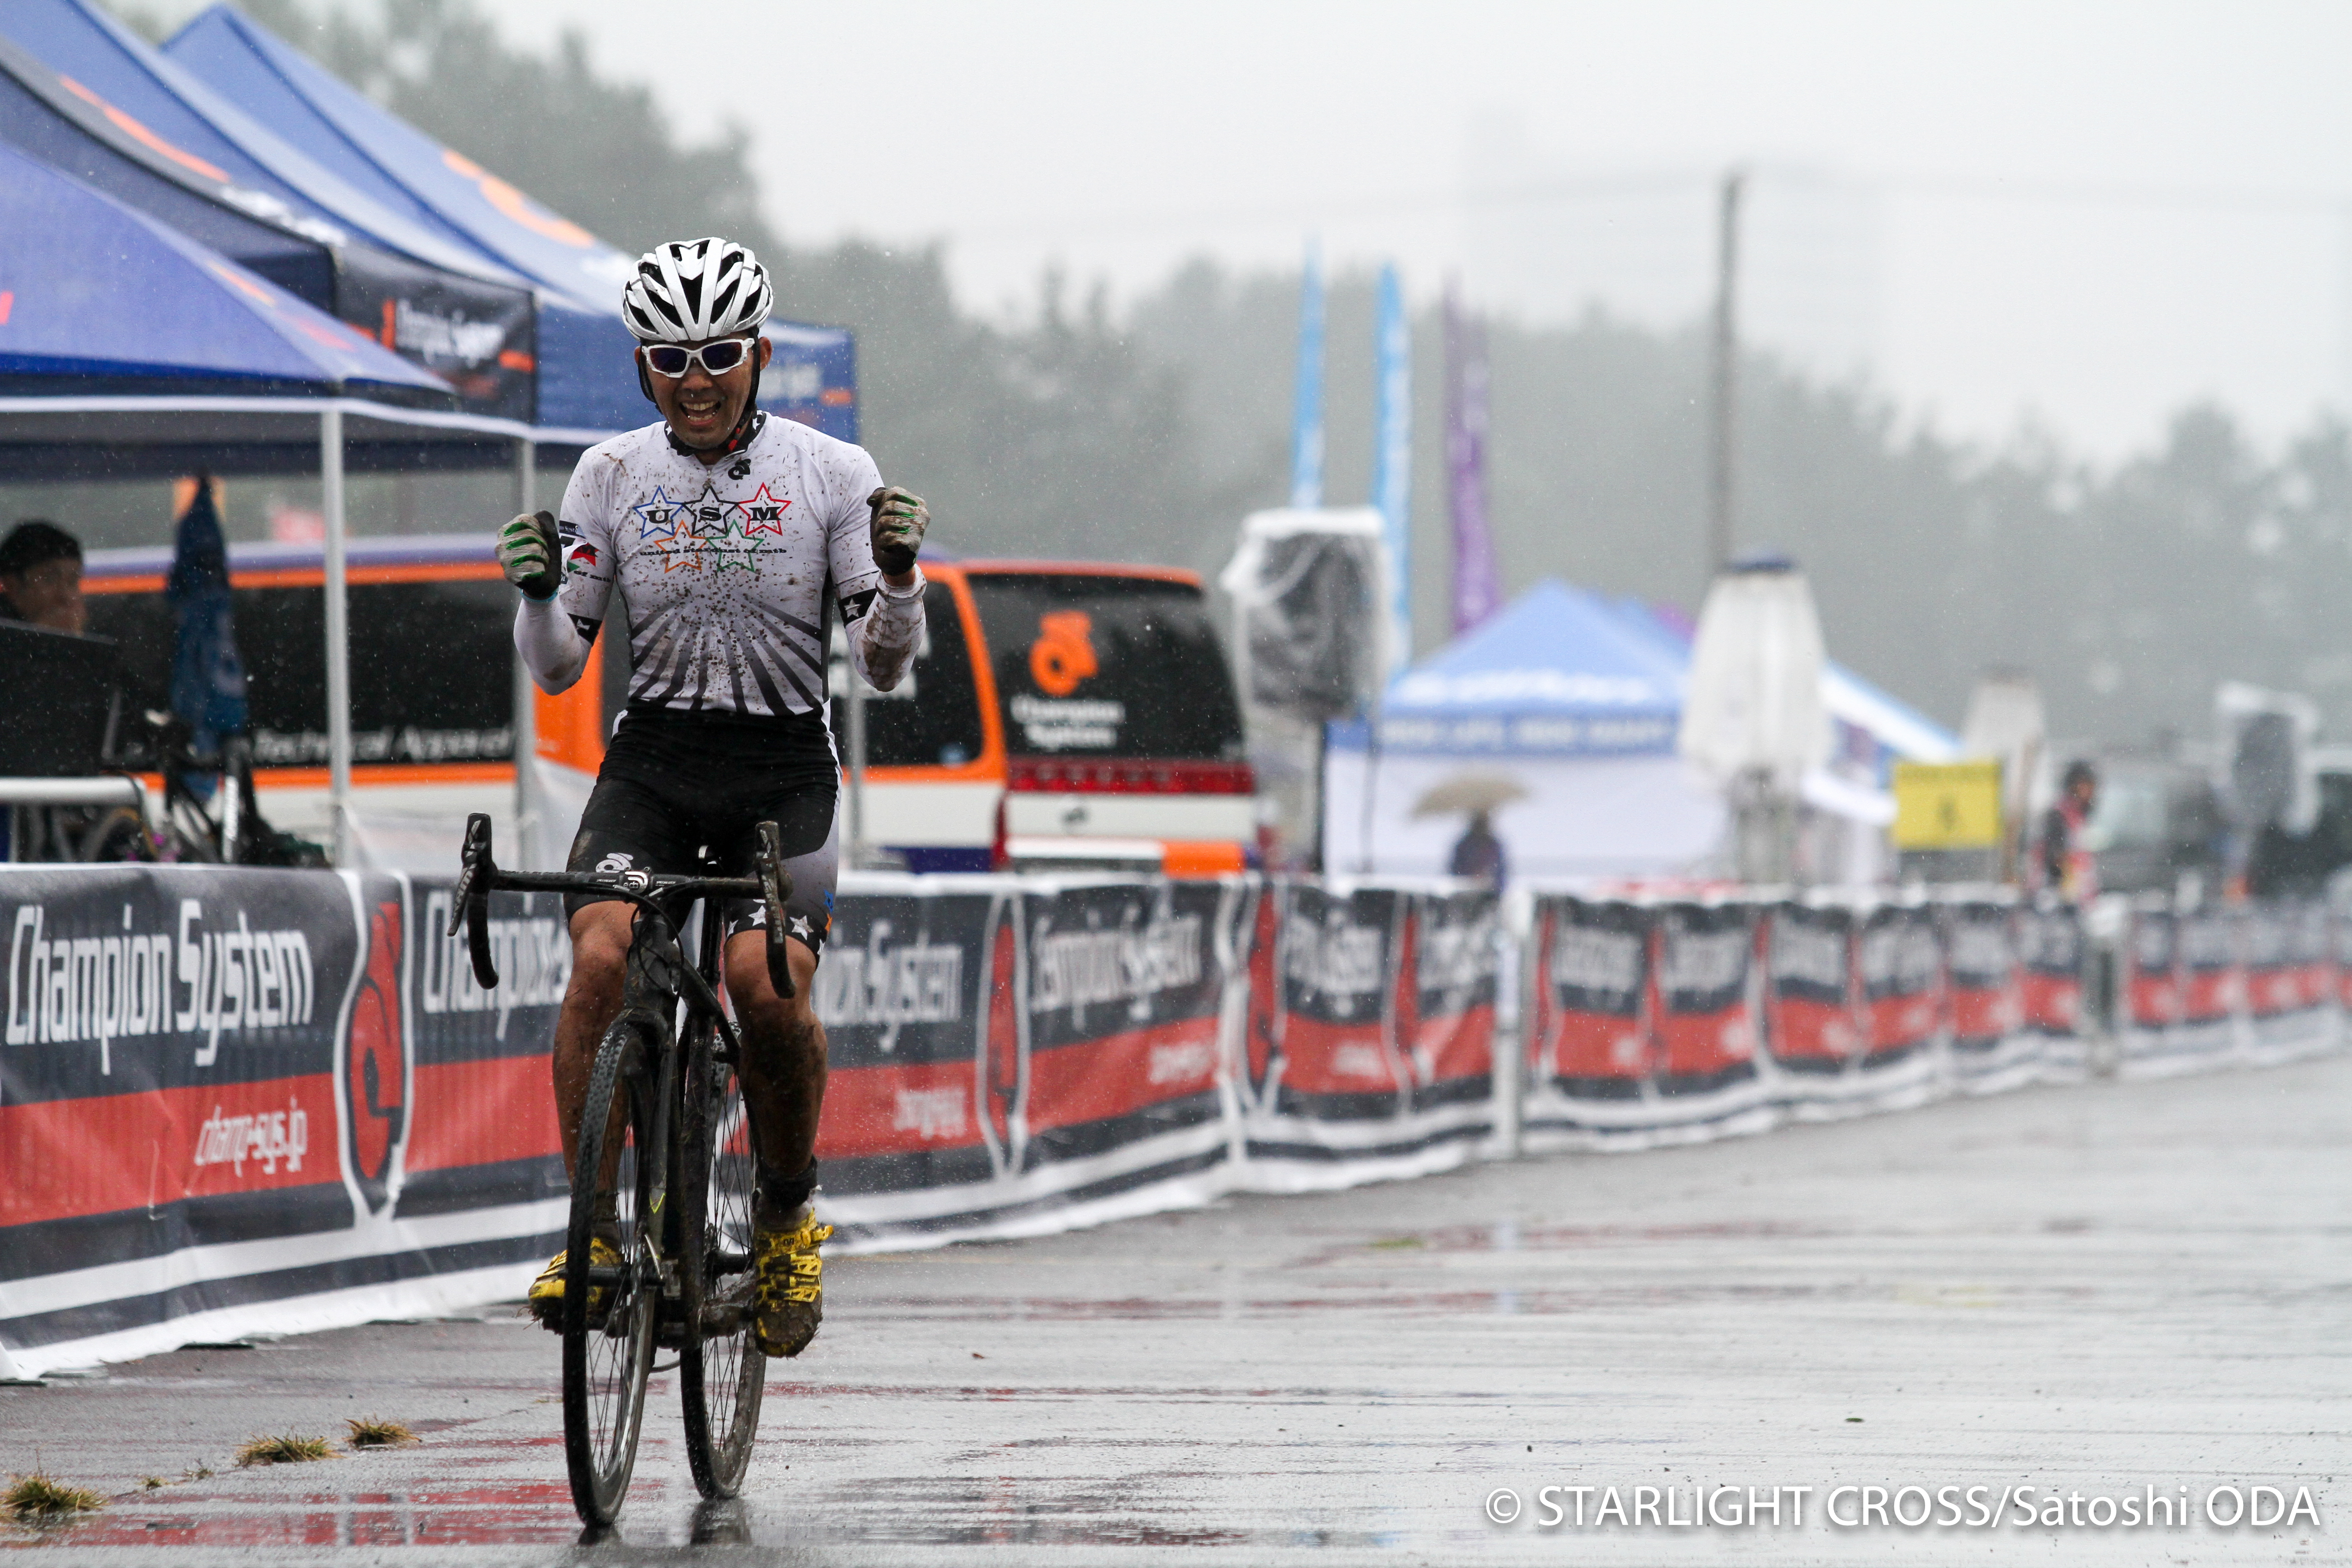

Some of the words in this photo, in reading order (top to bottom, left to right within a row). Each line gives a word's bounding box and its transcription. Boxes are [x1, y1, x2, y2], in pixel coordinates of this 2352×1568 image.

[646, 509, 673, 524] U
[699, 507, 722, 522] S
[749, 506, 781, 521] M
[6, 903, 173, 1076] Champion
[177, 899, 315, 1068] System
